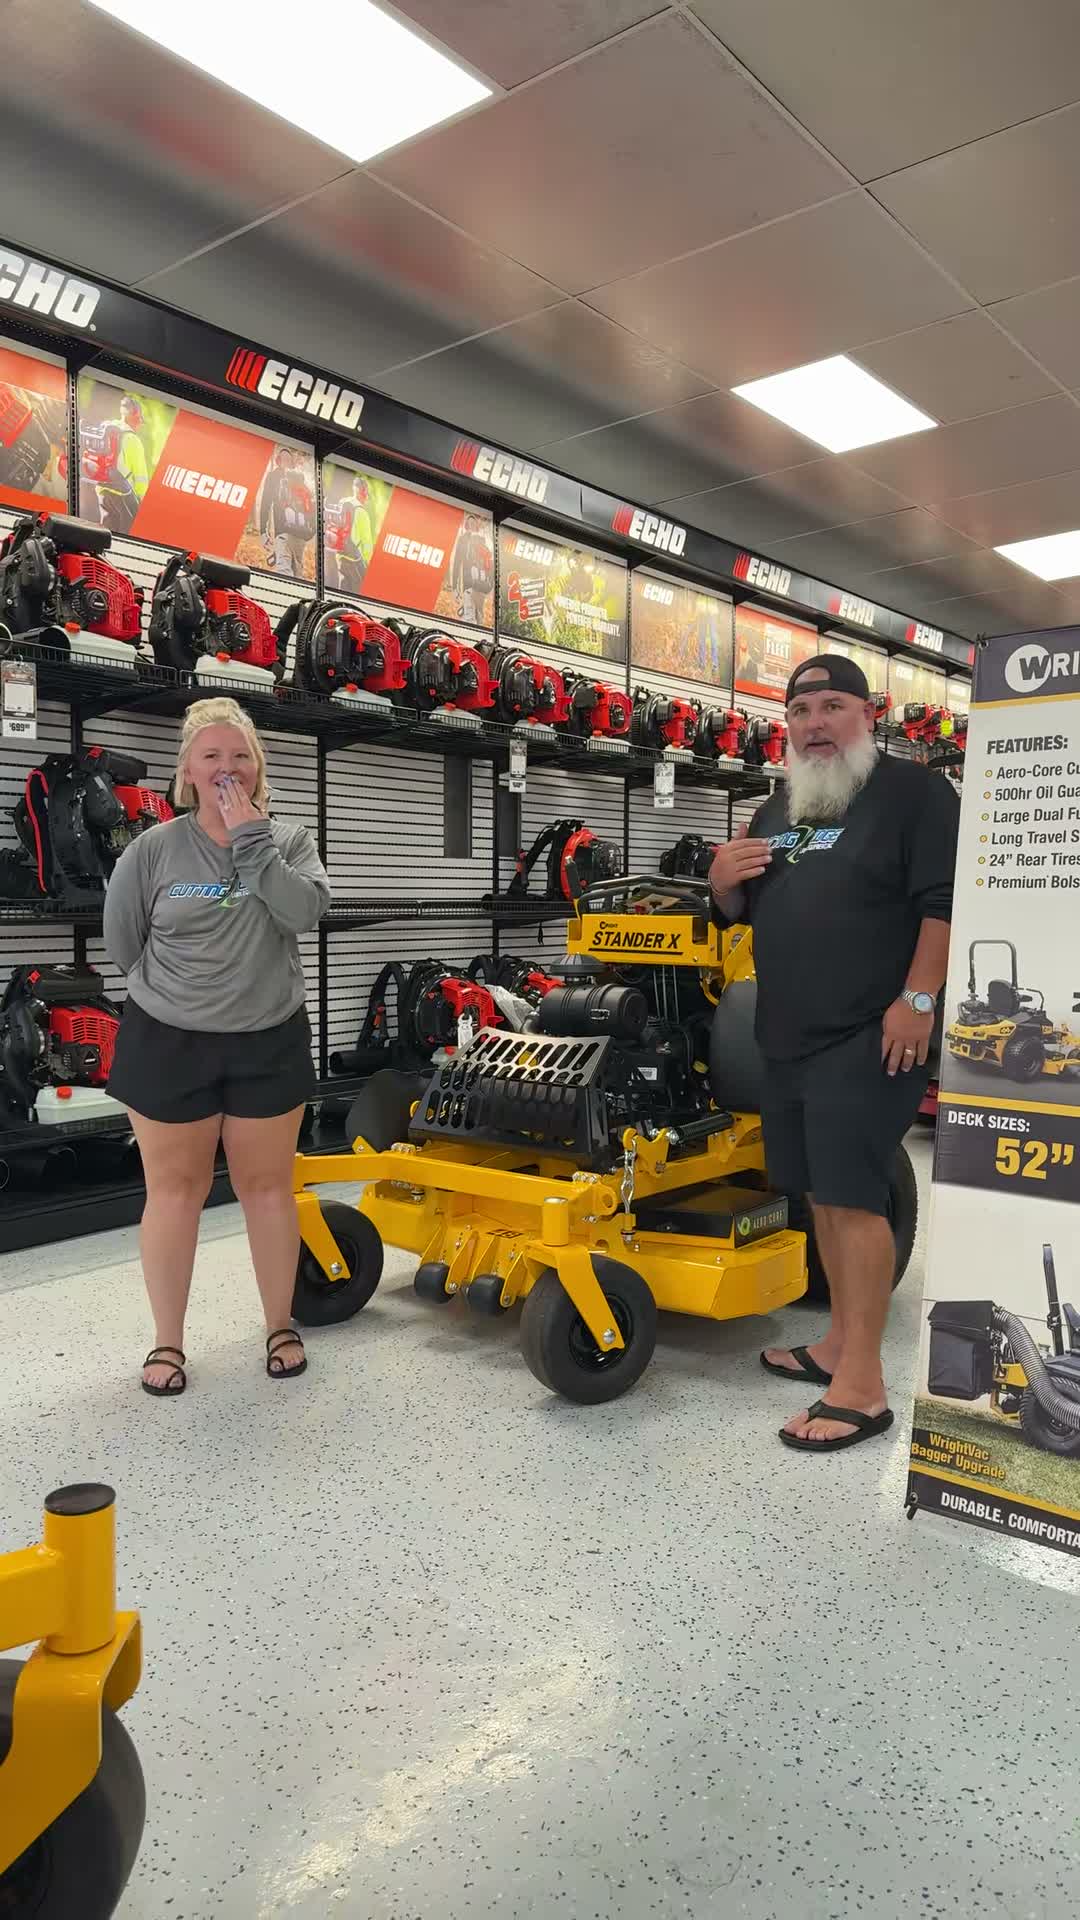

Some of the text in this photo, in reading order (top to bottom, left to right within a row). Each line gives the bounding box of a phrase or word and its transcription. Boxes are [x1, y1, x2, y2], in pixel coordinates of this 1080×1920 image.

[257, 359, 365, 430] ECHO
[181, 470, 248, 508] ECHO
[472, 446, 549, 504] ECHO
[628, 510, 687, 556] ECHO
[396, 537, 445, 569] ECHO
[514, 539, 554, 567] ECHO
[746, 557, 792, 595] ECHO
[642, 583, 674, 606] ECHO
[838, 594, 874, 627] ECHO
[913, 624, 943, 652] ECHO
[987, 735, 1068, 754] FEATURES:
[996, 764, 1062, 779] Aero-Core
[995, 787, 1032, 801] 500hr
[1036, 786, 1053, 799] Oil
[993, 811, 1030, 825] Large
[1034, 808, 1063, 821] Dual
[992, 829, 1080, 847] Long Travel S
[1016, 854, 1047, 866] Rear
[169, 883, 231, 899] CUTTING
[988, 876, 1080, 888] Premium Bols
[592, 930, 681, 949] STANDER X
[948, 1111, 1030, 1132] DECK SIZES:
[911, 1443, 1006, 1479] Bagger Upgrade
[929, 1433, 989, 1461] WrightVac
[940, 1492, 1004, 1524] DURABLE.
